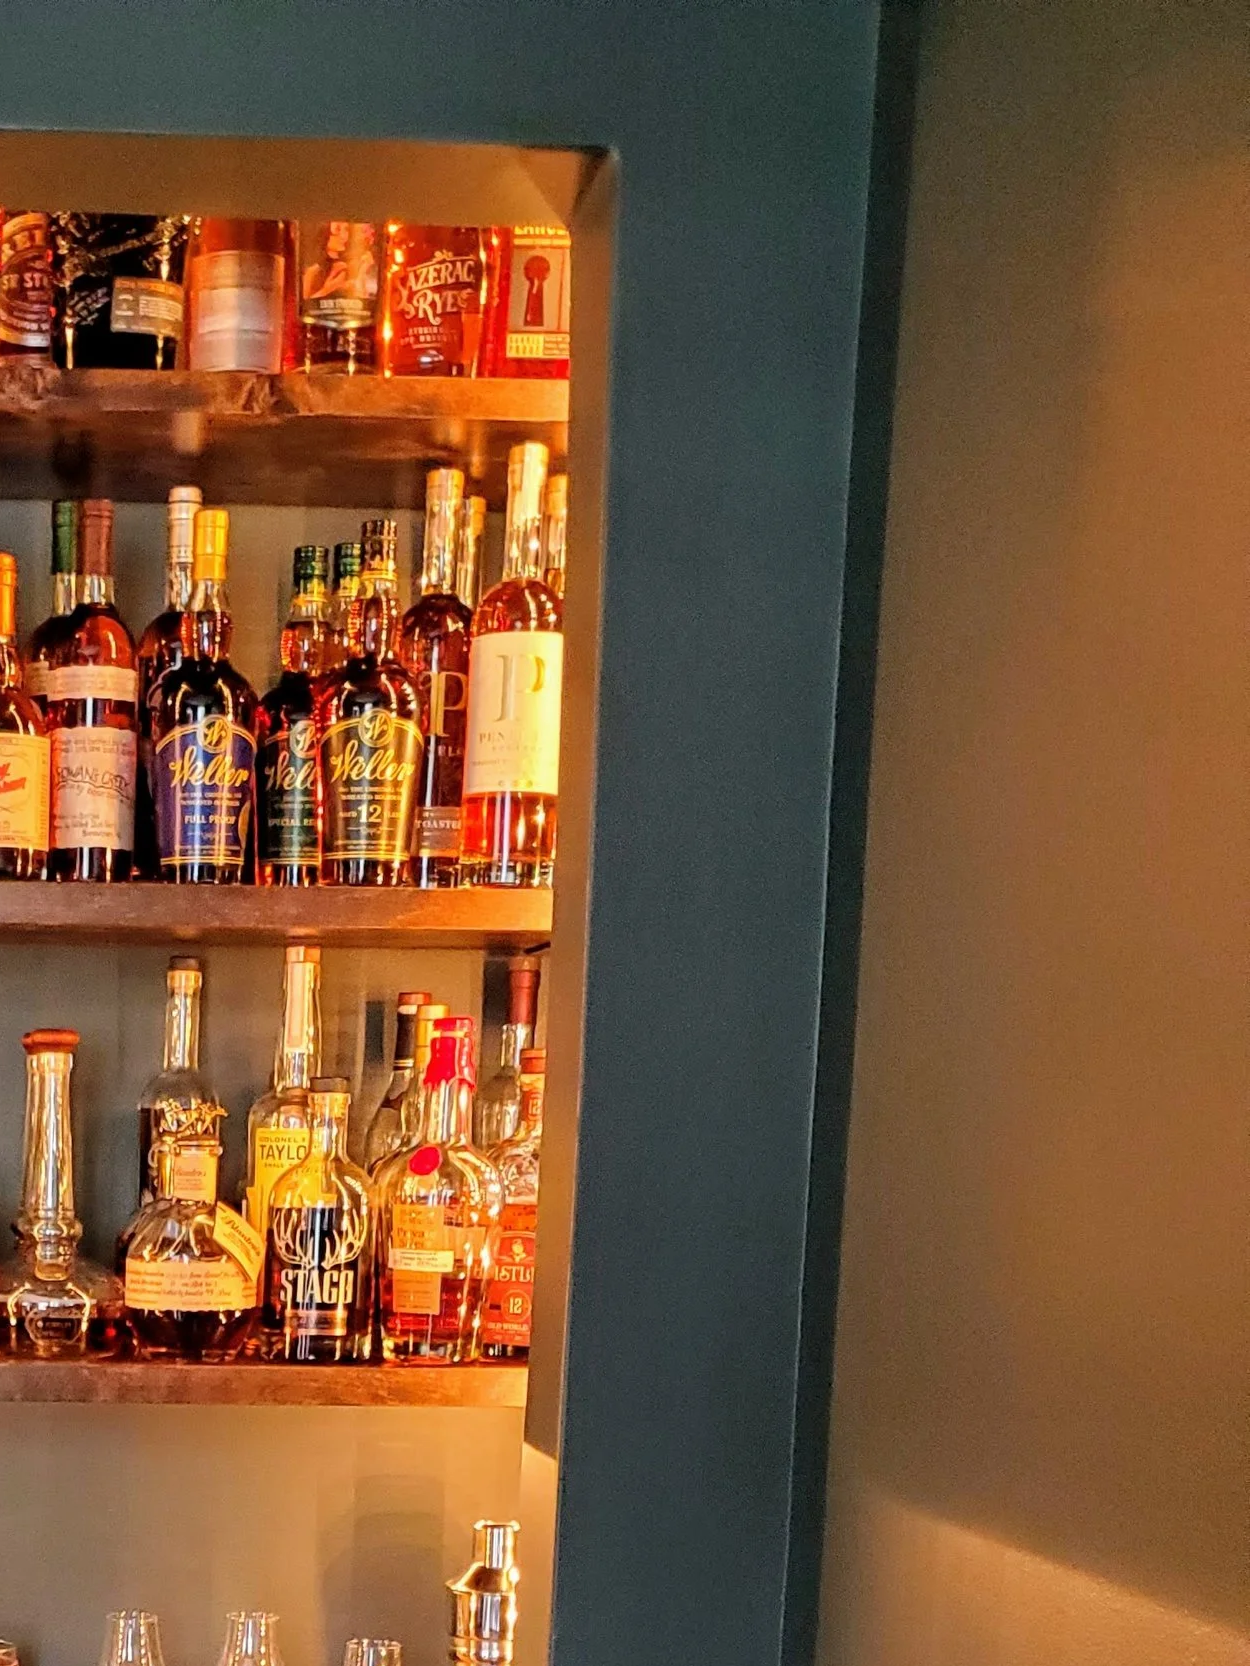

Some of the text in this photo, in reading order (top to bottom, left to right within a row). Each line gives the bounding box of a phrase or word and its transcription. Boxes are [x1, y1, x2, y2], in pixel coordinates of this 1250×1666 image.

[395, 260, 476, 319] SAZERAC
[168, 746, 250, 787] Weller
[331, 739, 416, 783] Weller
[184, 815, 207, 825] FULL
[357, 803, 382, 823] 12
[279, 1268, 354, 1304] STAGG
[509, 1297, 523, 1314] 12
